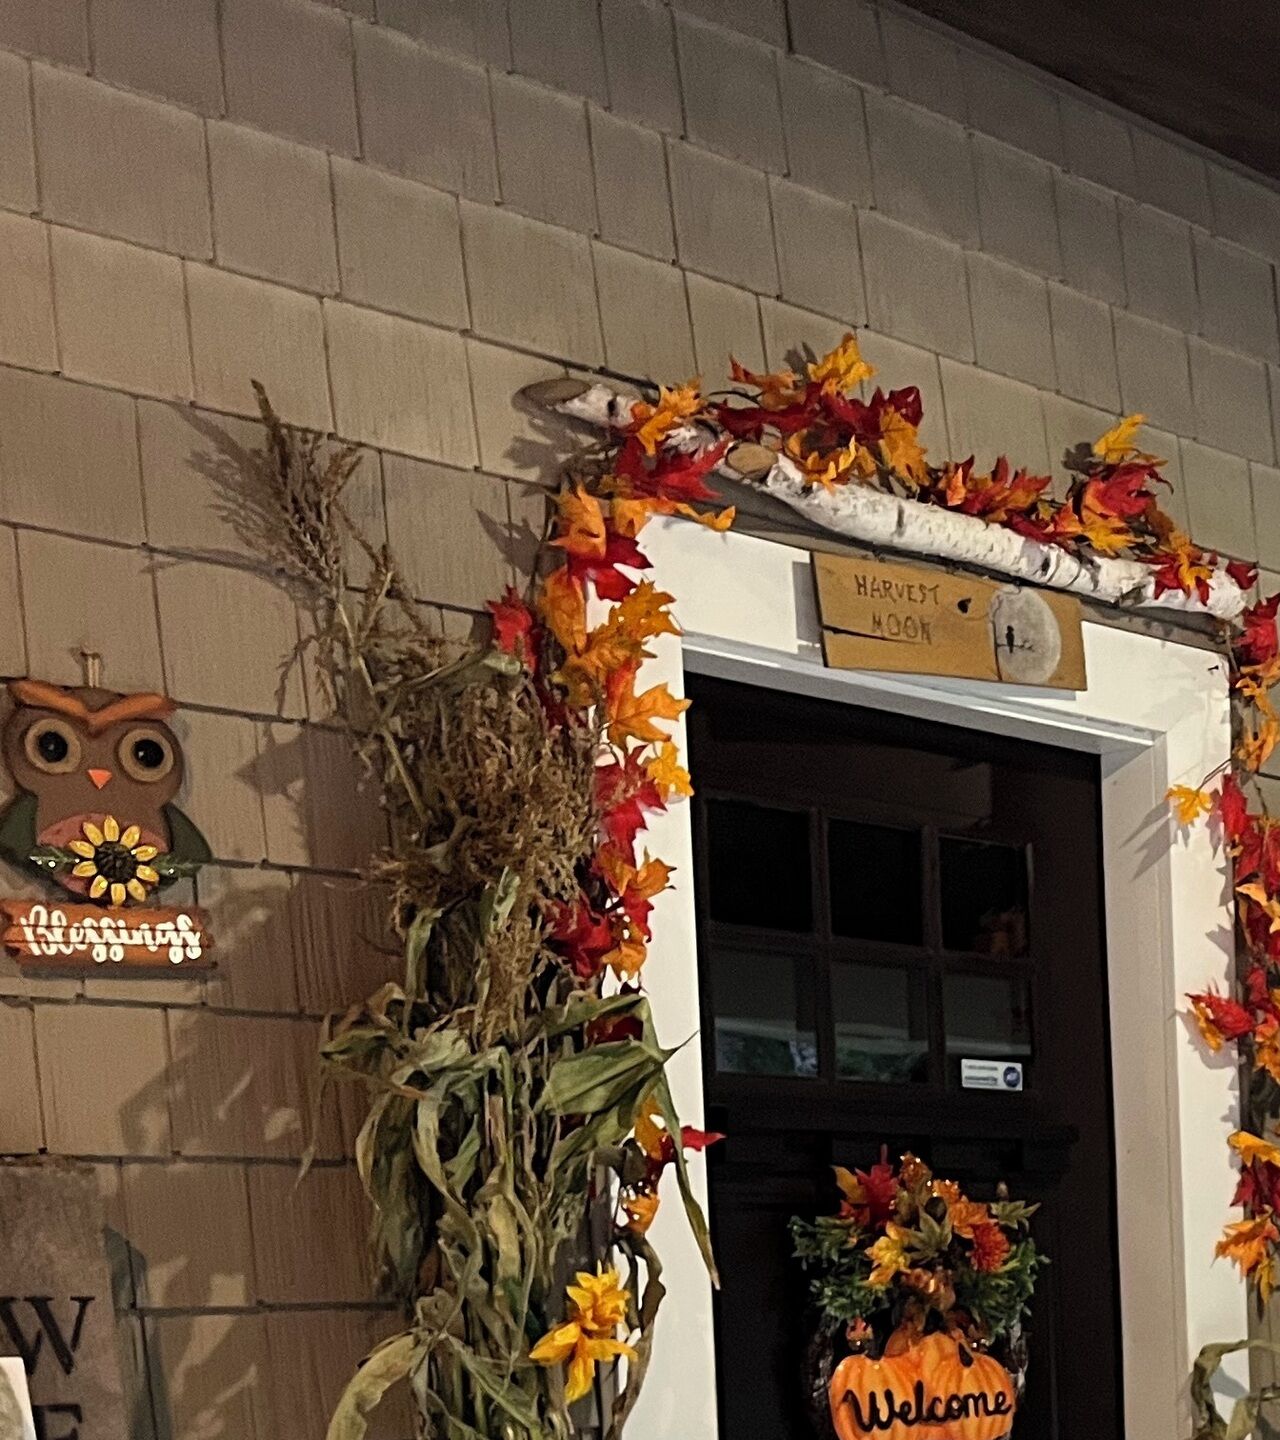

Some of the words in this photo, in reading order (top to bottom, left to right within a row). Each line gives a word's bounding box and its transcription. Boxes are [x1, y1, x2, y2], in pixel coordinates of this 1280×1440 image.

[854, 573, 941, 607] HARVEST
[871, 613, 932, 646] MOON
[19, 904, 202, 966] Blessings
[842, 1379, 1014, 1433] Welcome
